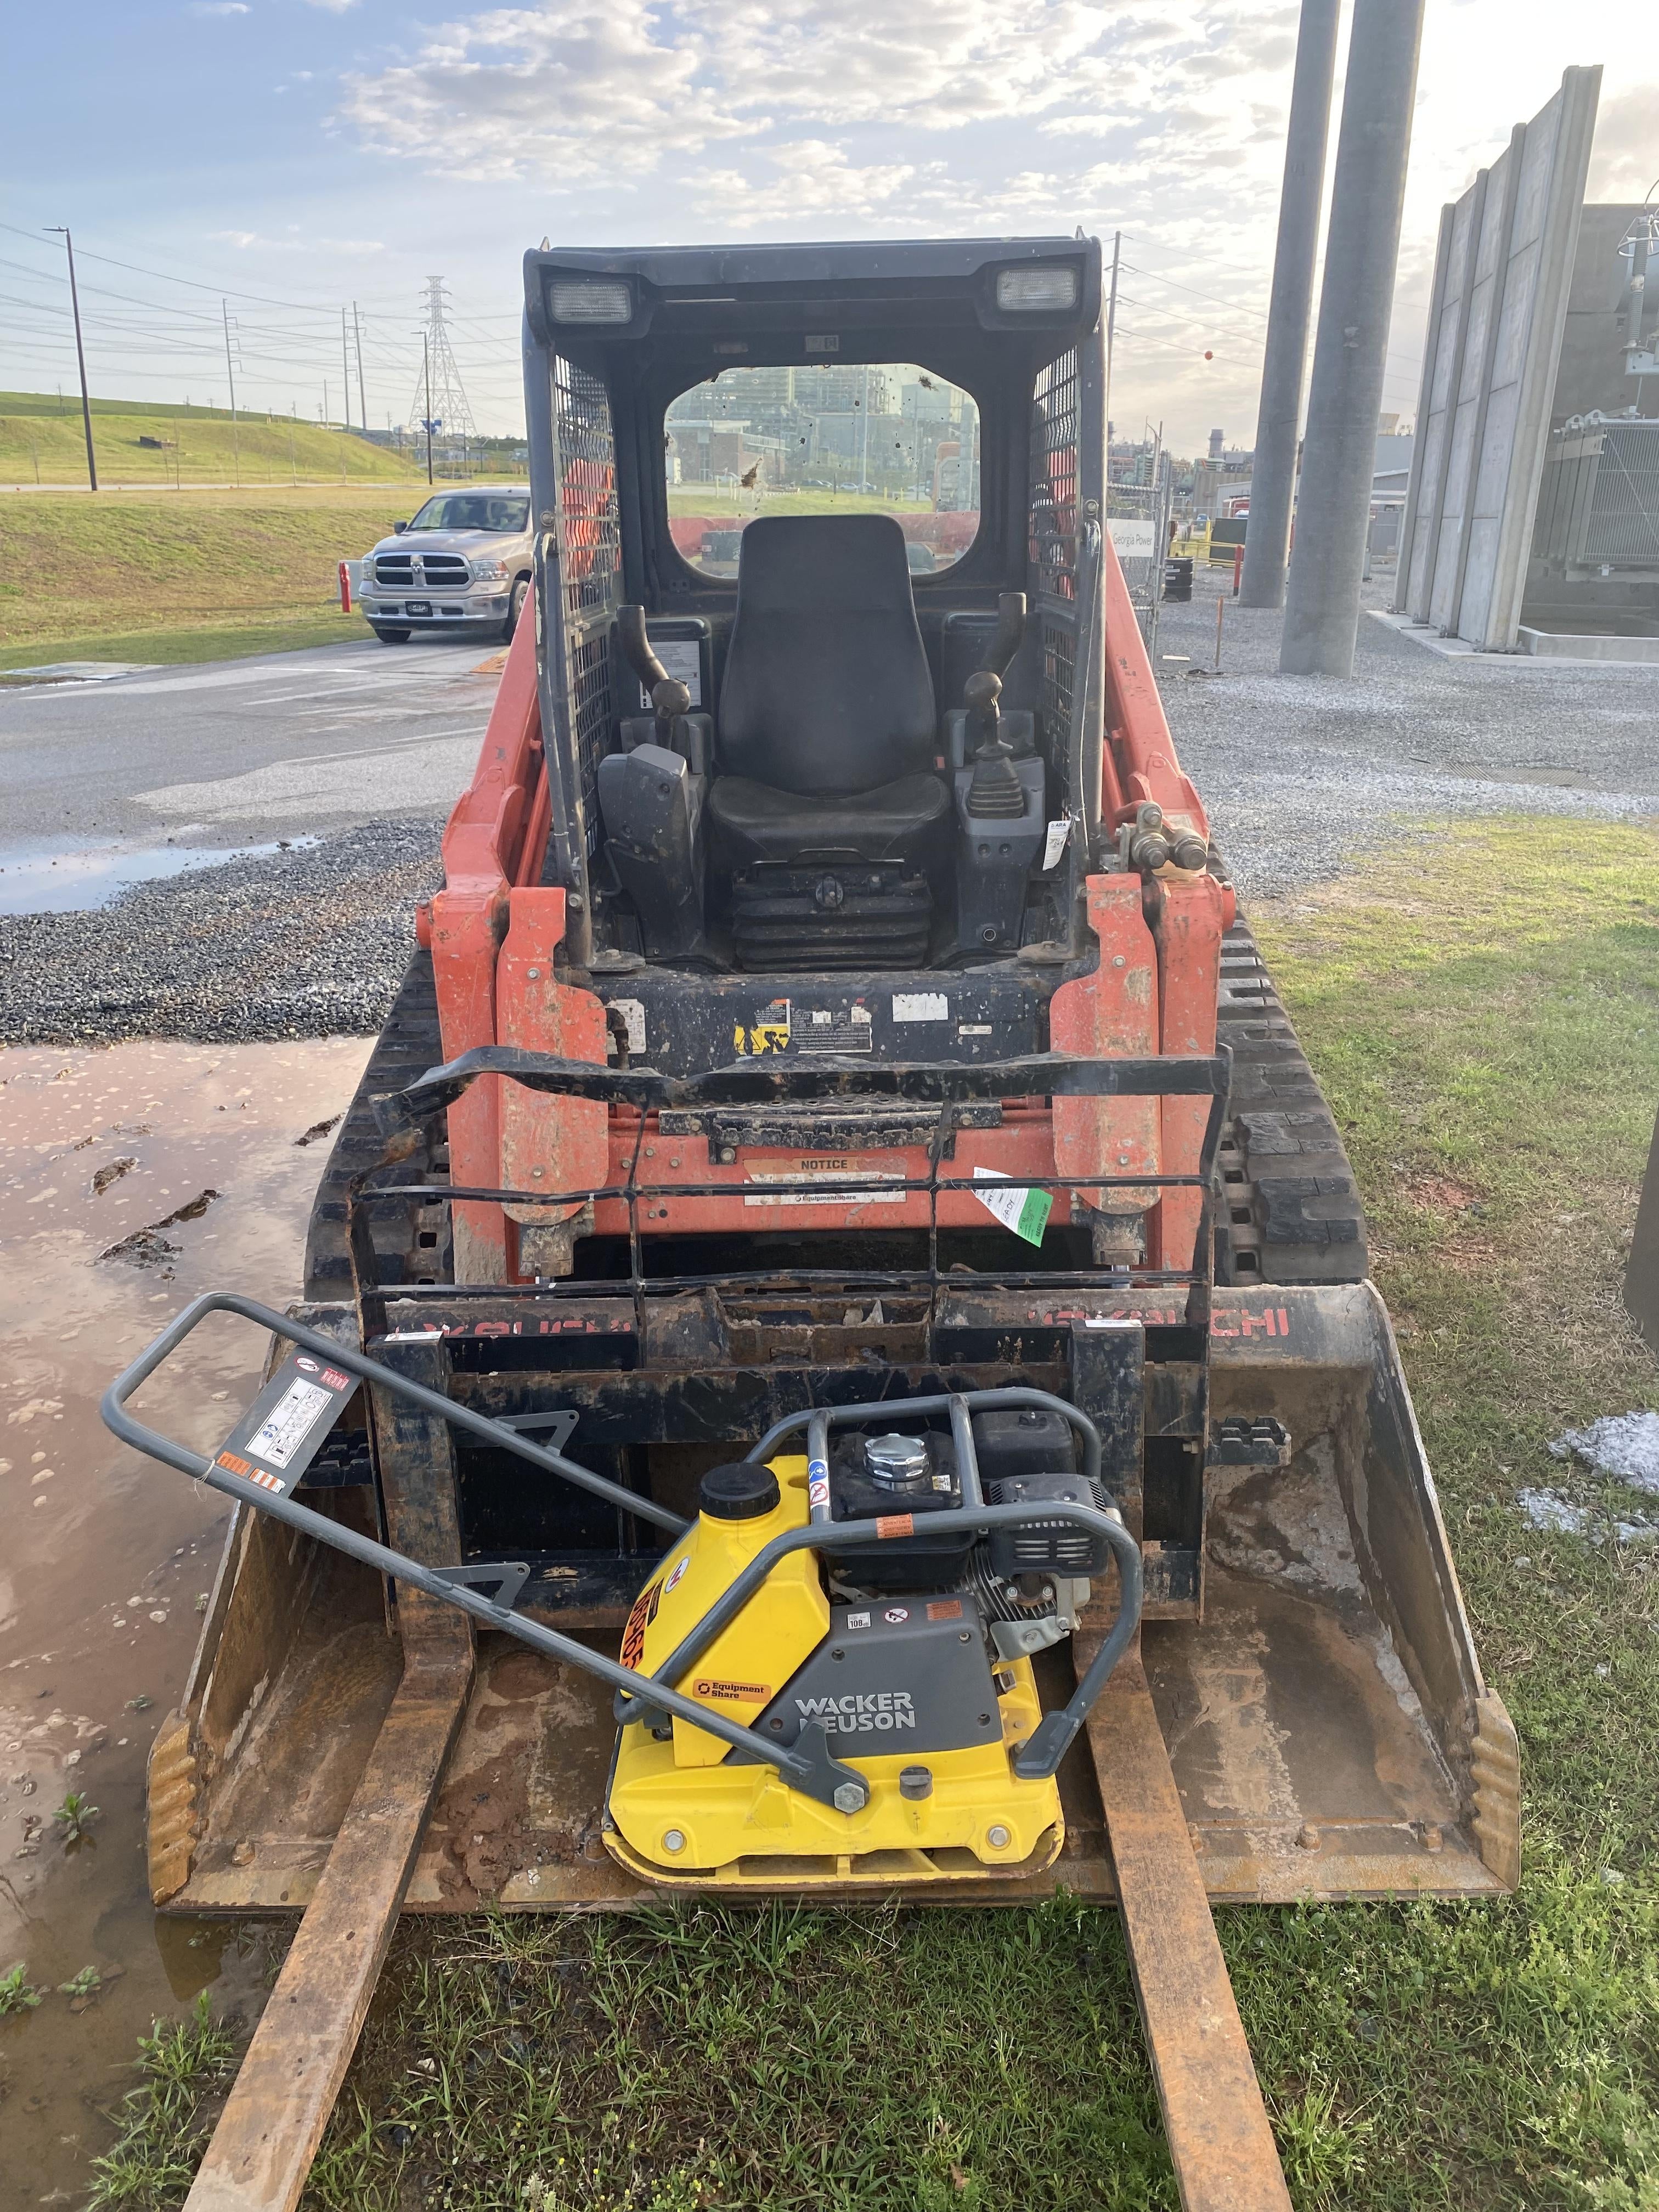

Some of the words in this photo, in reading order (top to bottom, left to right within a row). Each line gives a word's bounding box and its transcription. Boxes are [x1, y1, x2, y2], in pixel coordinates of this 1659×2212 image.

[1113, 533, 1135, 547] Georgia
[1136, 534, 1153, 545] Power
[801, 1160, 848, 1170] NOTICE
[850, 1620, 862, 1628] 108
[712, 1682, 765, 1694] Equipment
[711, 1690, 740, 1699] Share
[795, 1692, 915, 1717] WACKER
